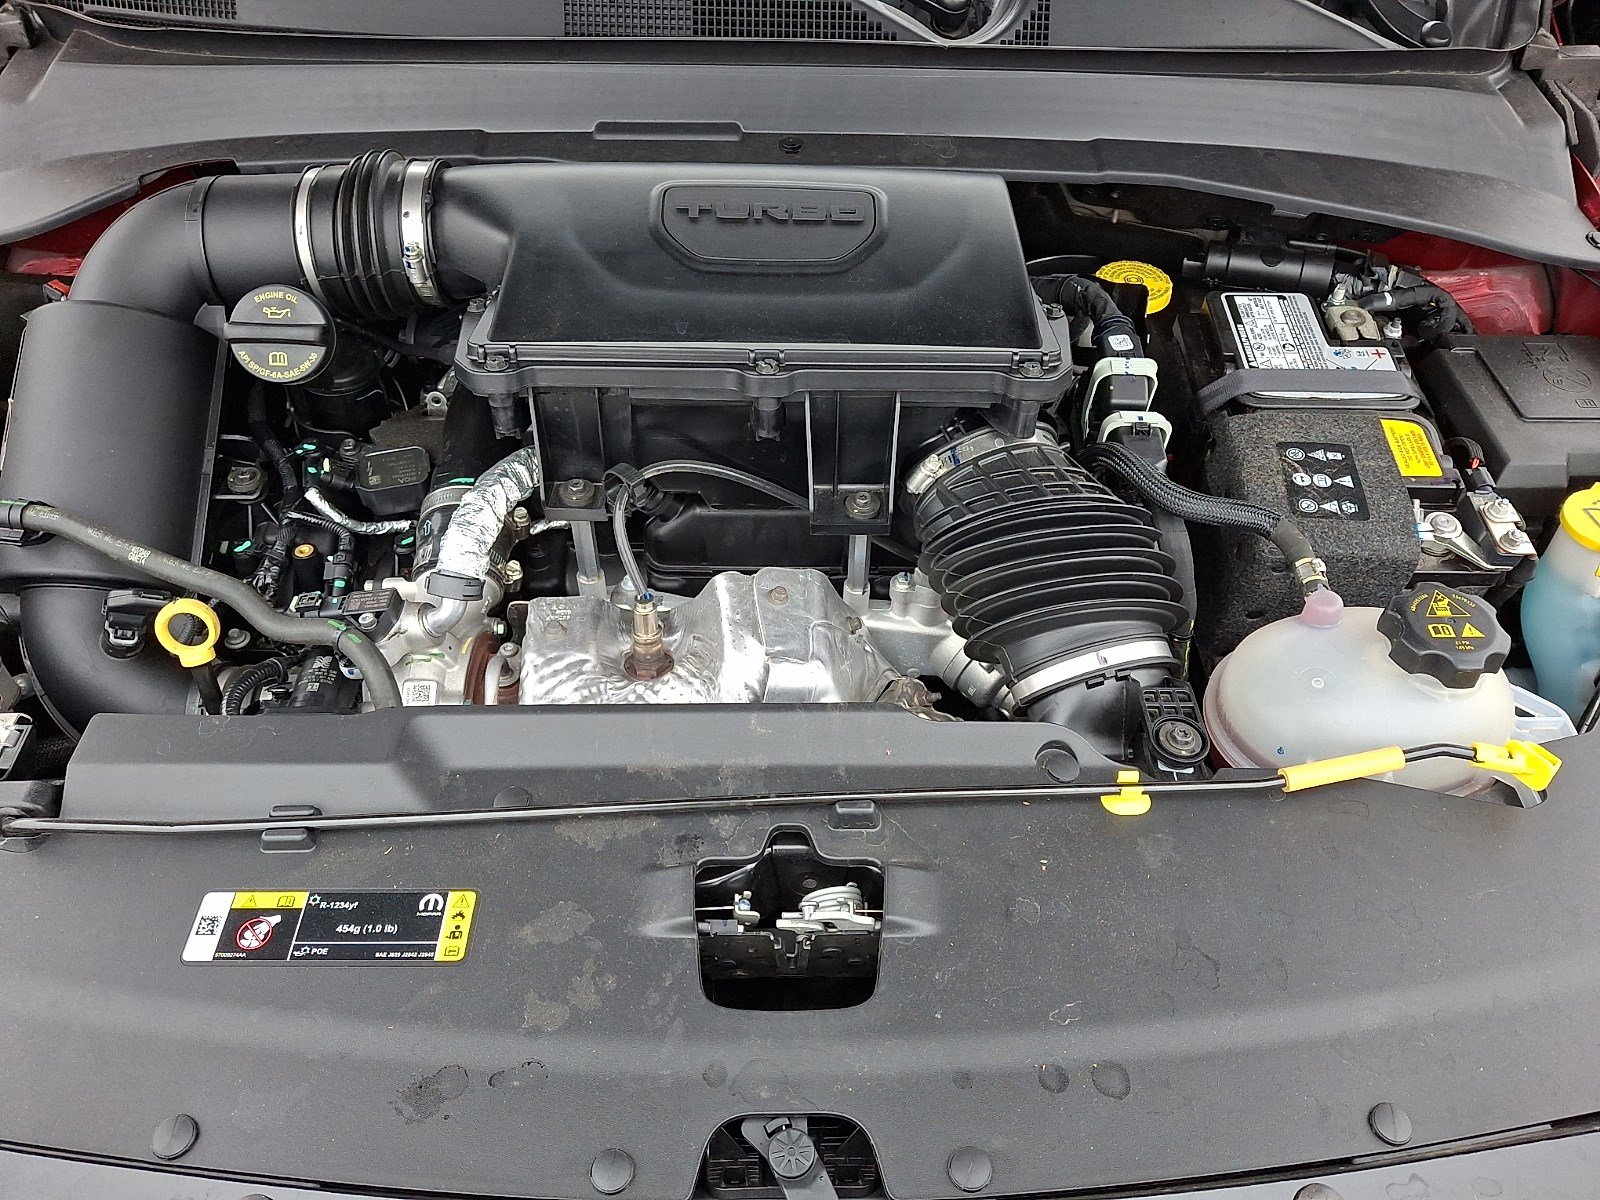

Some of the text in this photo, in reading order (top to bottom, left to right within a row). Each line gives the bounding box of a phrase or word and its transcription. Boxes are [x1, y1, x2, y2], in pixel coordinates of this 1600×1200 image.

[676, 202, 864, 222] TURBO
[254, 291, 298, 304] ENGINE OIL
[238, 350, 248, 364] API
[320, 901, 359, 910] R-1234yf
[336, 924, 398, 934] 454g (1.0 lb)
